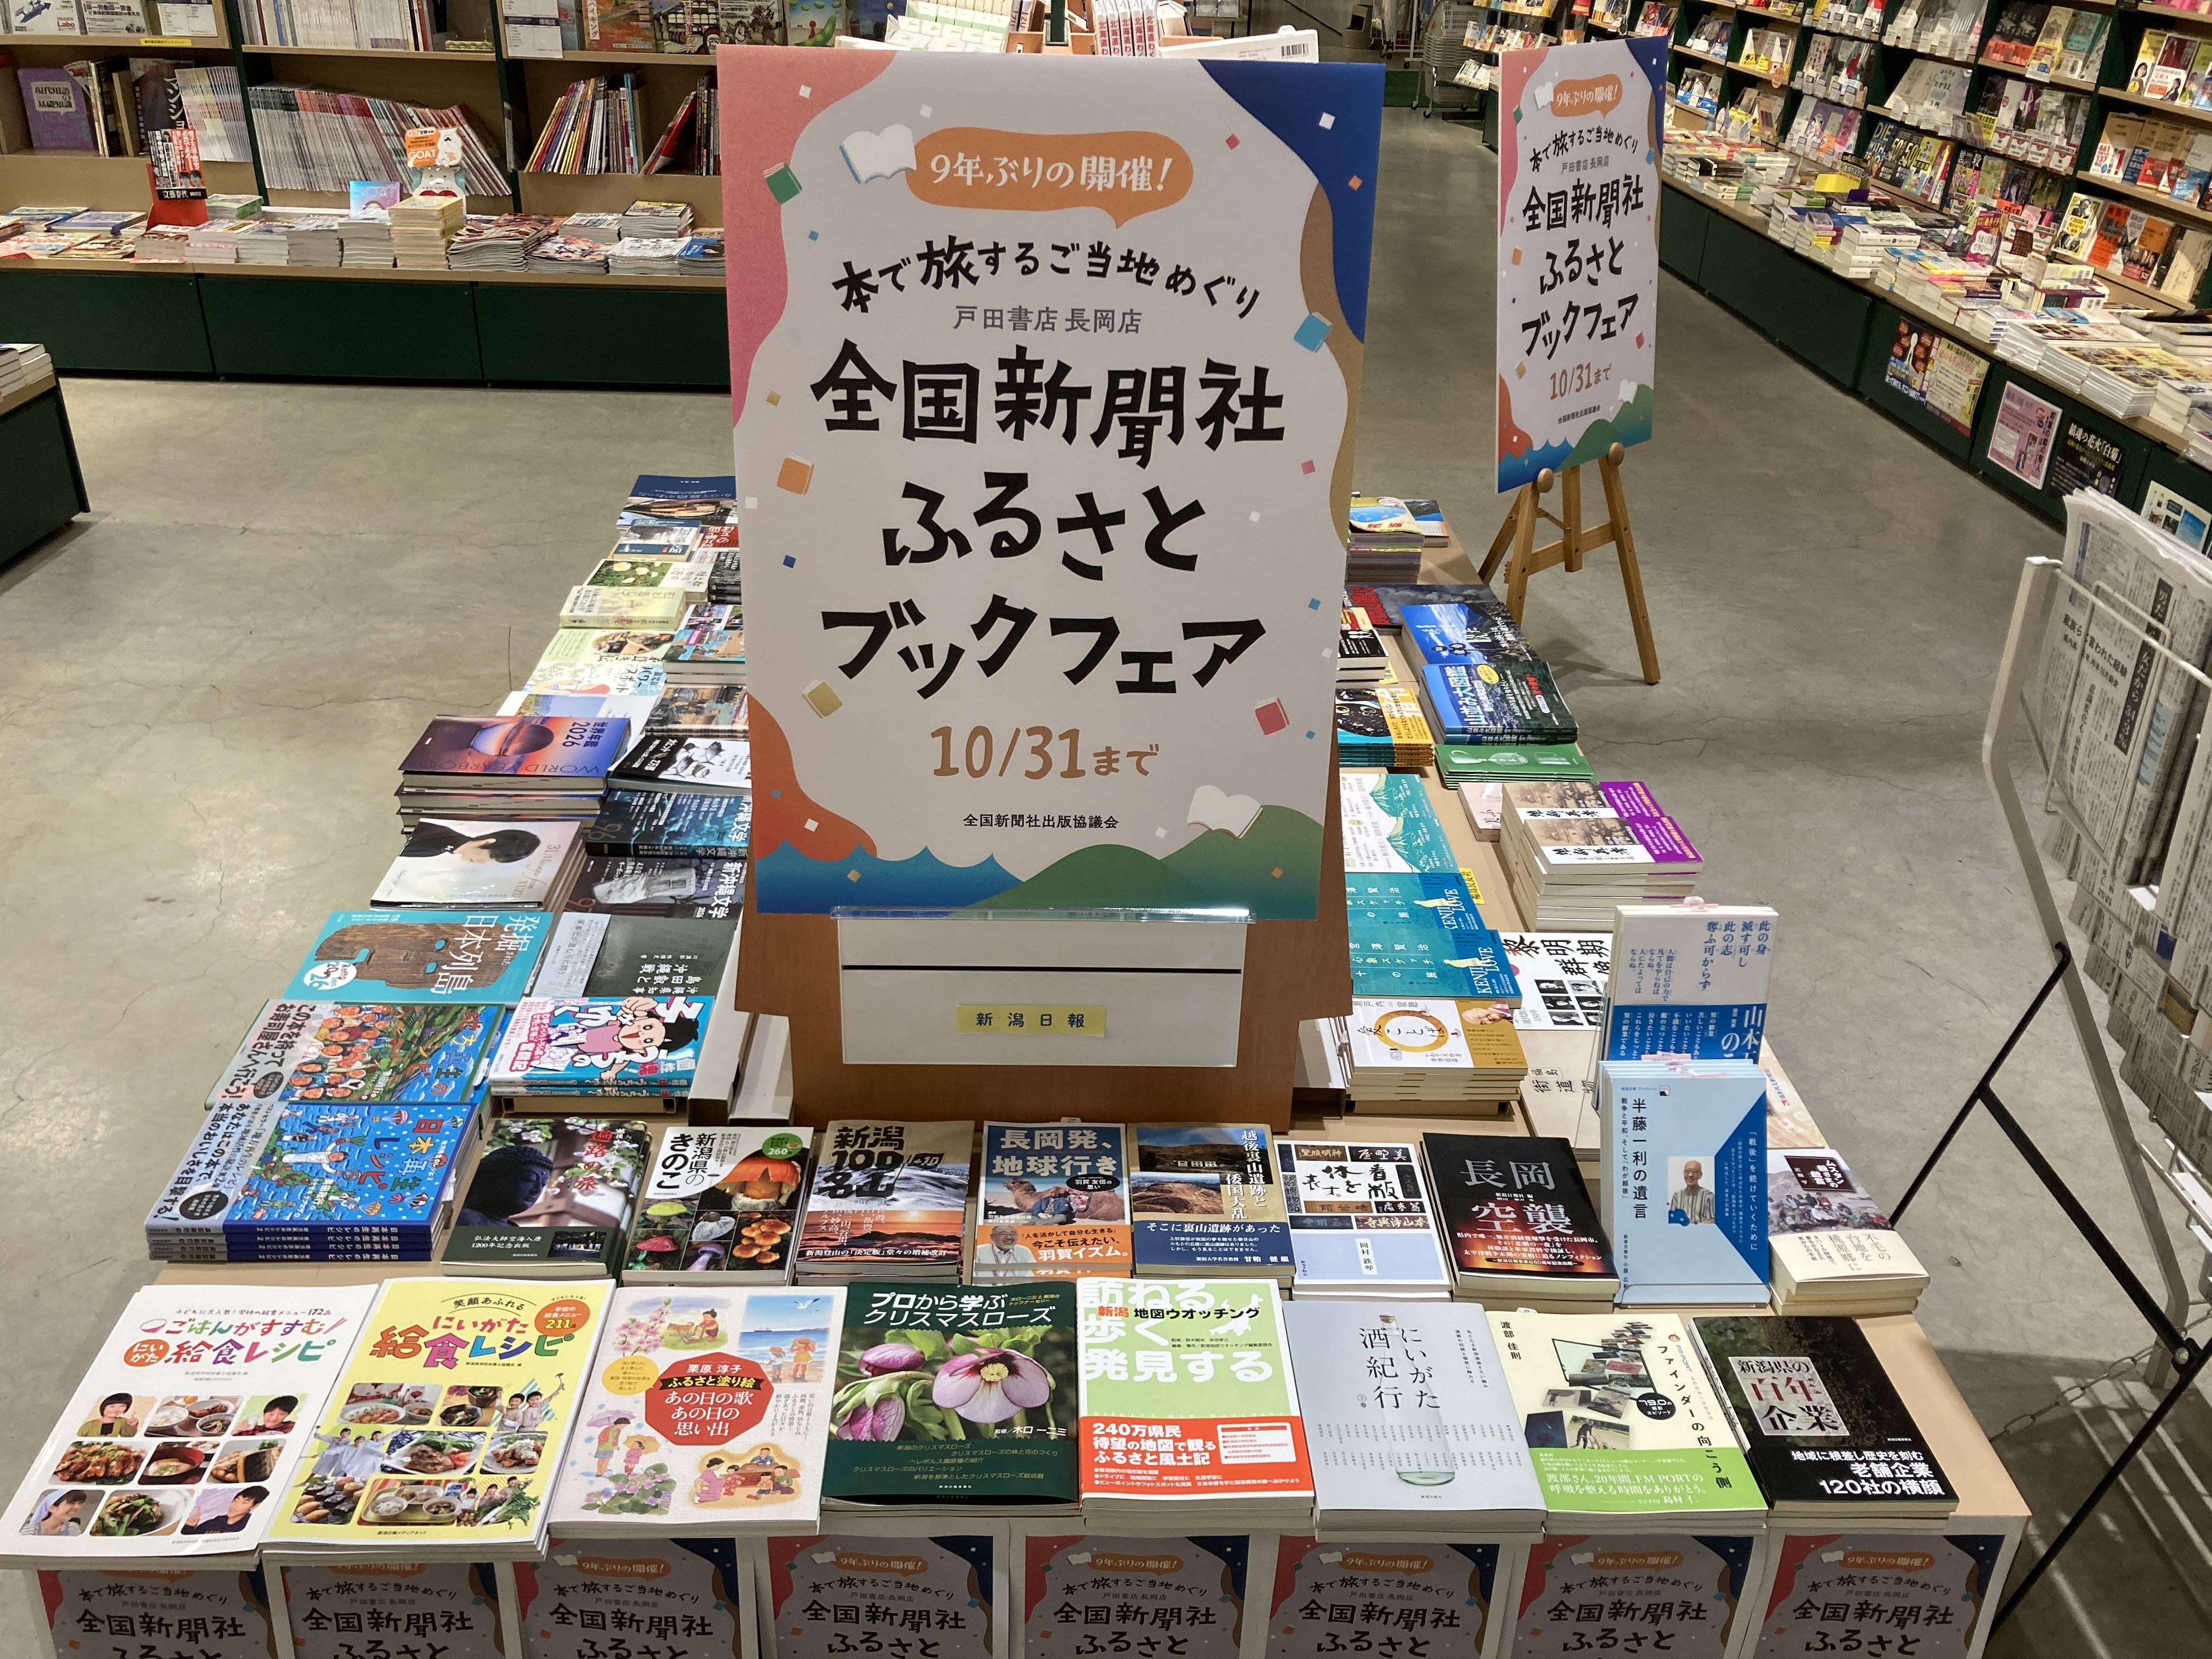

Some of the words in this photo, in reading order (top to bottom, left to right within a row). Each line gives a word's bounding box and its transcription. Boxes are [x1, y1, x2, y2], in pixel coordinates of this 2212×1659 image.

[1556, 84, 1618, 107] 9年ぶりの開催!
[408, 149, 437, 159] GOAT
[1530, 125, 1639, 173] 本で旅するご当地めぐり
[931, 153, 1172, 194] 9年ぶりの開催!
[1561, 157, 1589, 174] 戸田書店
[1589, 155, 1610, 170] 長岡店
[1522, 174, 1644, 232] 全国新聞社
[831, 233, 1261, 320] 本で旅するご当地めぐり
[1539, 236, 1624, 295] ふるさと
[952, 304, 1059, 332] 戸田書店
[1065, 307, 1142, 335] 長岡店
[1522, 293, 1639, 360] ブックフェア
[1550, 362, 1612, 400] 10/31まで
[809, 337, 1286, 470] 全国新聞社
[1558, 404, 1601, 424] 全国新聞社出版協議会
[882, 471, 1207, 582] ふるさと
[821, 593, 1268, 700] ブックフェア
[1443, 665, 1487, 726] 山並み大図鑑
[562, 722, 591, 747] 2026
[583, 722, 608, 748] 世界年鑑
[930, 725, 1160, 781] 10/31まで
[962, 812, 1119, 830] 全国新聞社出版協議会
[708, 861, 745, 919] 新沖縄文学
[1367, 911, 1411, 919] の旅
[1437, 906, 1459, 929] KENJI
[494, 913, 541, 967] 発掘された
[1348, 943, 1430, 952] 宮澤賢治
[1502, 933, 1611, 958] 黎明期
[1720, 921, 1735, 956] 此の志
[1756, 921, 1770, 955] 此の身
[433, 912, 487, 996] 日本列島
[1352, 957, 1434, 965] 心象スケッチ
[1478, 947, 1500, 972] LOVE
[1355, 970, 1438, 980] 十の旅
[1469, 966, 1493, 994] KENJI
[976, 1011, 1085, 1029] 新潟日報
[1357, 1023, 1446, 1038] 愛ことば
[272, 1004, 317, 1068] この本を持って
[224, 1003, 289, 1101] お寿司屋さんへ行こう!
[405, 1028, 447, 1077] レシピ
[430, 1011, 483, 1096] 地方再生の
[1531, 1068, 1559, 1077] 福島
[199, 1104, 251, 1183] あなたはこの本で、
[833, 1125, 905, 1150] 新潟
[999, 1130, 1113, 1149] 長岡発、
[154, 1103, 234, 1222] 本当のおいしさを目撃する!
[358, 1137, 400, 1192] レシピ
[387, 1118, 444, 1205] 日本再生の
[654, 1132, 695, 1189] きのこ
[684, 1132, 718, 1187] 新潟県の
[831, 1150, 904, 1171] 100
[992, 1155, 1118, 1176] 地球行き
[1241, 1130, 1267, 1207] 越後裏山遺跡と
[1632, 1098, 1647, 1219] 半藤一利の遺言
[819, 1170, 899, 1198] 名山
[1460, 1159, 1556, 1190] 長岡
[1225, 1172, 1248, 1220] 倭国大乱
[1748, 1131, 1758, 1251] 「戦後」を続けていくために
[1146, 1222, 1281, 1234] そこに裏山遺跡があった
[1471, 1202, 1575, 1235] 空襲
[805, 1249, 947, 1258] 新潟登山の「決定版」堂々の増補改訂
[1031, 1238, 1121, 1247] 今こそ伝えたい、
[1037, 1246, 1129, 1261] 羽賀イズム。
[1829, 1234, 1861, 1271] 桃源郷に
[1846, 1233, 1872, 1261] 台地を
[1863, 1233, 1891, 1261] 不毛の
[452, 1296, 526, 1311] 笑顔あふれる
[871, 1292, 1008, 1311] プロから学ぶ
[1083, 1282, 1216, 1311] 訪ねる
[432, 1315, 529, 1333] にいがた
[864, 1306, 1056, 1327] クリスマスローズ
[1098, 1306, 1130, 1317] 新潟
[1134, 1307, 1260, 1319] 地図ウオッチング
[1084, 1313, 1169, 1347] 歩く
[1500, 1321, 1515, 1339] 渡部
[1508, 1342, 1522, 1360] 佳則
[129, 1352, 160, 1363] がた
[132, 1342, 163, 1353] にい
[164, 1338, 337, 1365] 給食レシピ
[369, 1324, 575, 1369] 給食レシピ
[686, 1364, 712, 1373] 栗原
[716, 1364, 742, 1373] 淳子
[1085, 1348, 1273, 1383] 発見する
[1358, 1327, 1403, 1409] 酒紀行
[1401, 1328, 1441, 1409] にいがた
[1737, 1360, 1810, 1374] 新潟県の
[668, 1375, 756, 1389] ふるさと塗り絵
[1743, 1376, 1822, 1402] 百年
[664, 1391, 753, 1406] あの日の歌
[671, 1406, 740, 1420] あの日の
[1657, 1345, 1733, 1488] ファインダーの向こう側
[1762, 1405, 1839, 1432] 企業
[674, 1421, 729, 1437] 思い出
[1036, 1427, 1067, 1436] 一二三
[1092, 1422, 1182, 1438] 240万県民
[1093, 1437, 1217, 1452] 待望の地図で観る
[1791, 1451, 1923, 1462] 地域に根差し歴史を刻む
[1093, 1452, 1211, 1466] ふるさと風土記
[1850, 1462, 1933, 1478] 老舗企業
[1549, 1484, 1707, 1496] 呼吸を整える時間をありがとう。
[1657, 1474, 1704, 1483] PORTの
[1819, 1479, 1945, 1496] 120社の横顔
[78, 1583, 228, 1606] 本で旅するご当地めぐり
[554, 1580, 699, 1605] 本で旅するご当地めぐり
[1062, 1576, 1208, 1599] 本で旅するご当地めぐり
[1807, 1573, 1953, 1596] 本で旅するご当地めぐり
[76, 1609, 246, 1644] 全国新聞社
[548, 1602, 714, 1641] 全国新聞社
[1053, 1599, 1217, 1633] 全国新聞社
[1791, 1598, 1957, 1629] 全国新聞社
[1074, 1630, 1189, 1657] ふるさと
[1804, 1627, 1923, 1658] ふるさと
